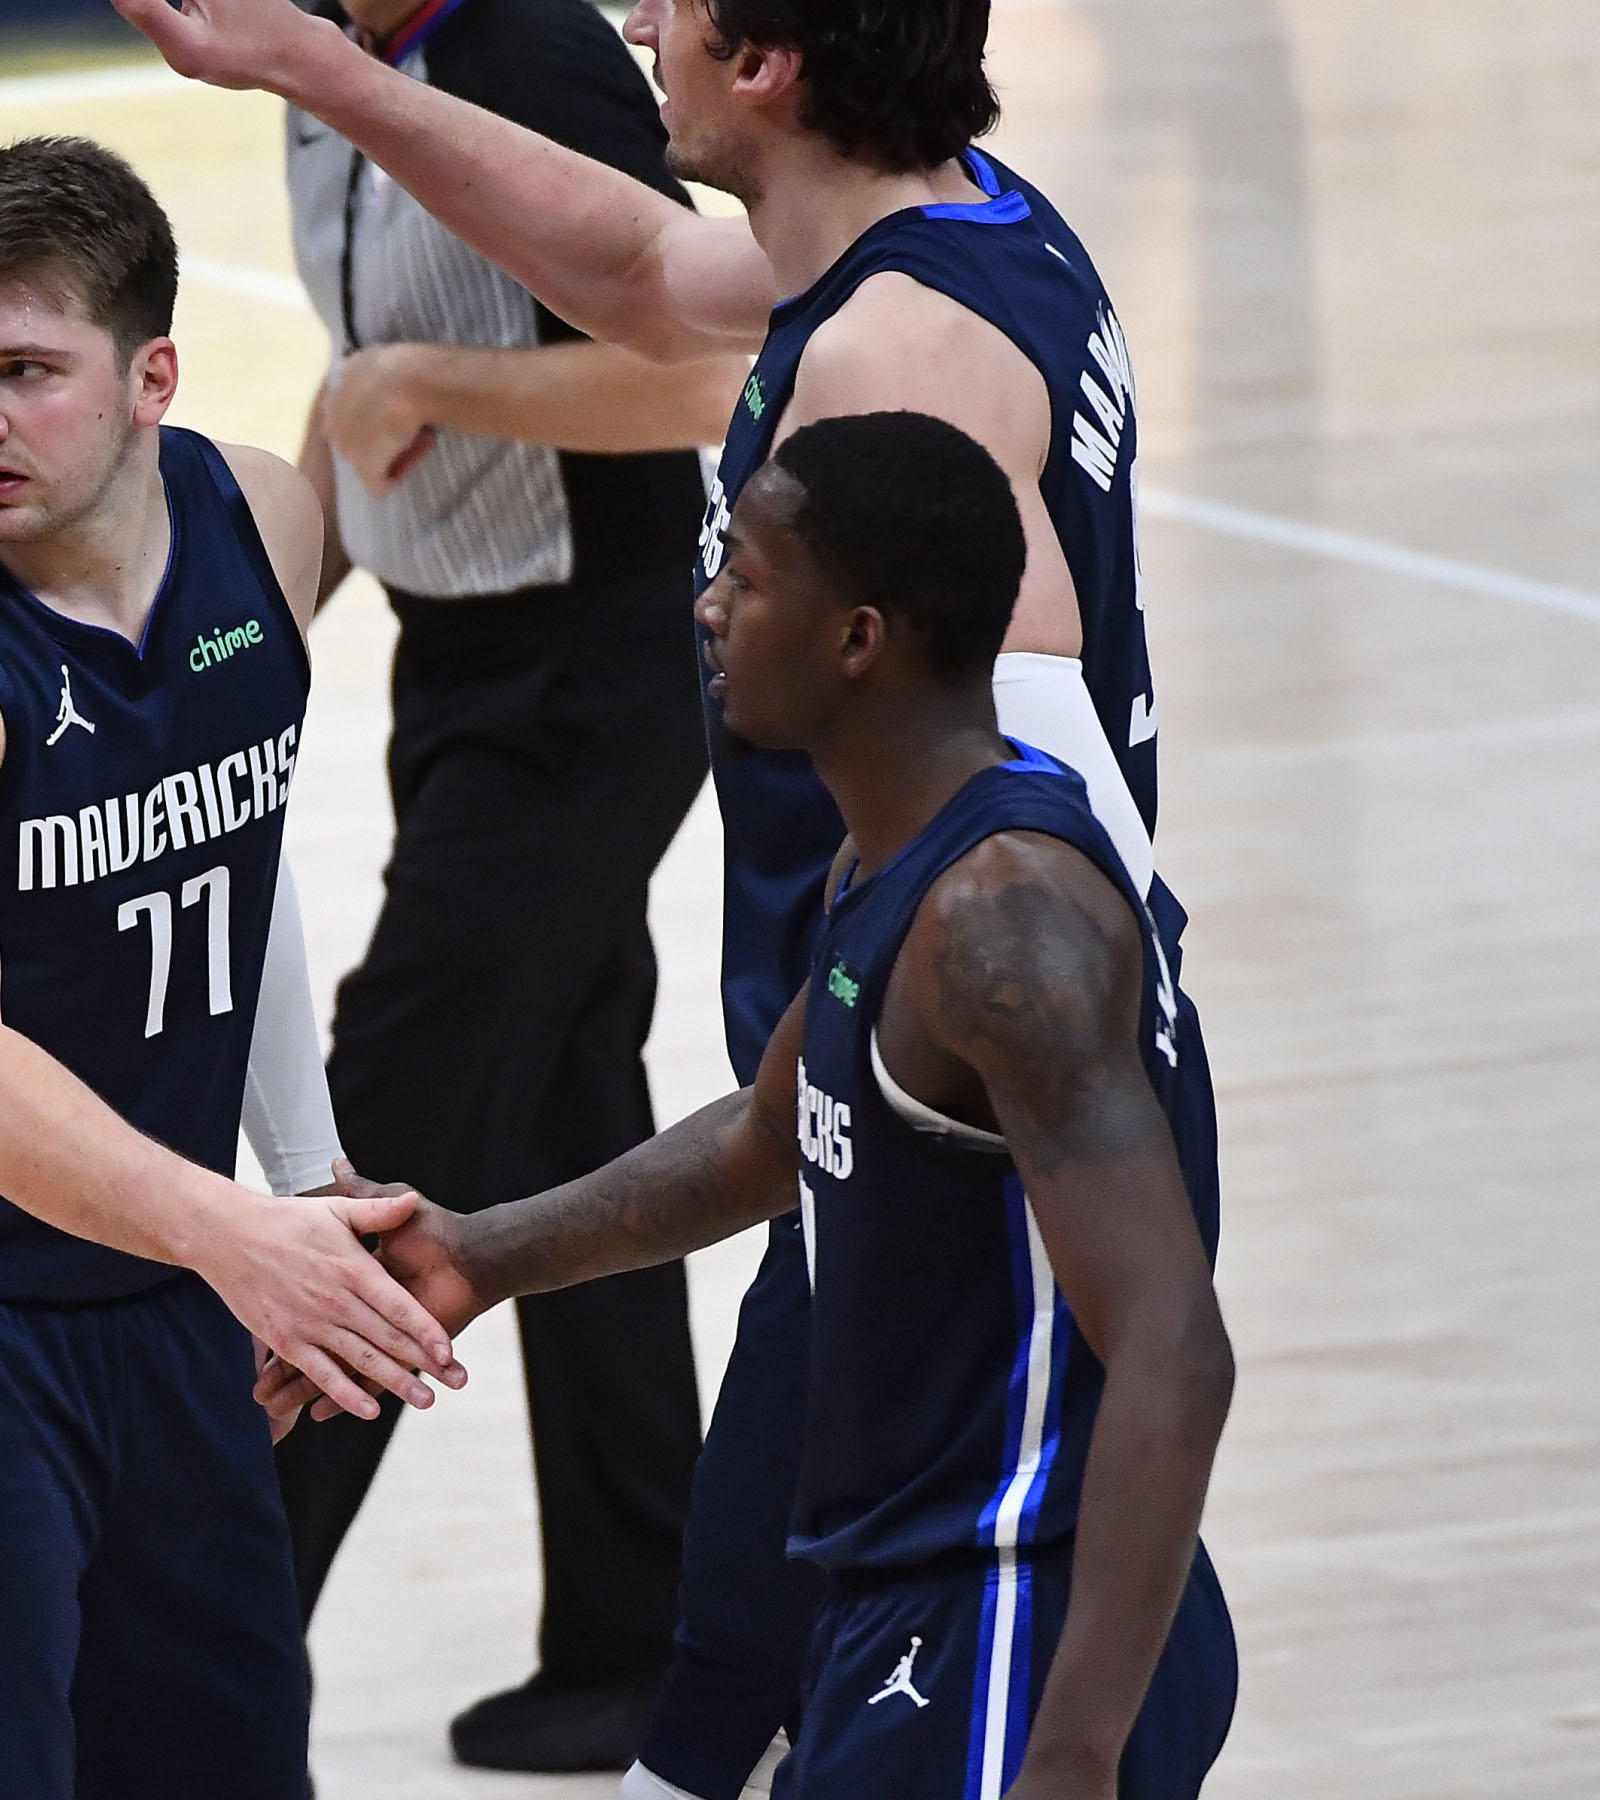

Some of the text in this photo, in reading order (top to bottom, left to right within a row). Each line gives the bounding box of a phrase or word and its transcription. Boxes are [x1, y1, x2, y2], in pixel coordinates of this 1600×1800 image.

[189, 618, 264, 673] chime
[18, 723, 297, 892] MAVERICKS
[117, 864, 234, 1039] 77
